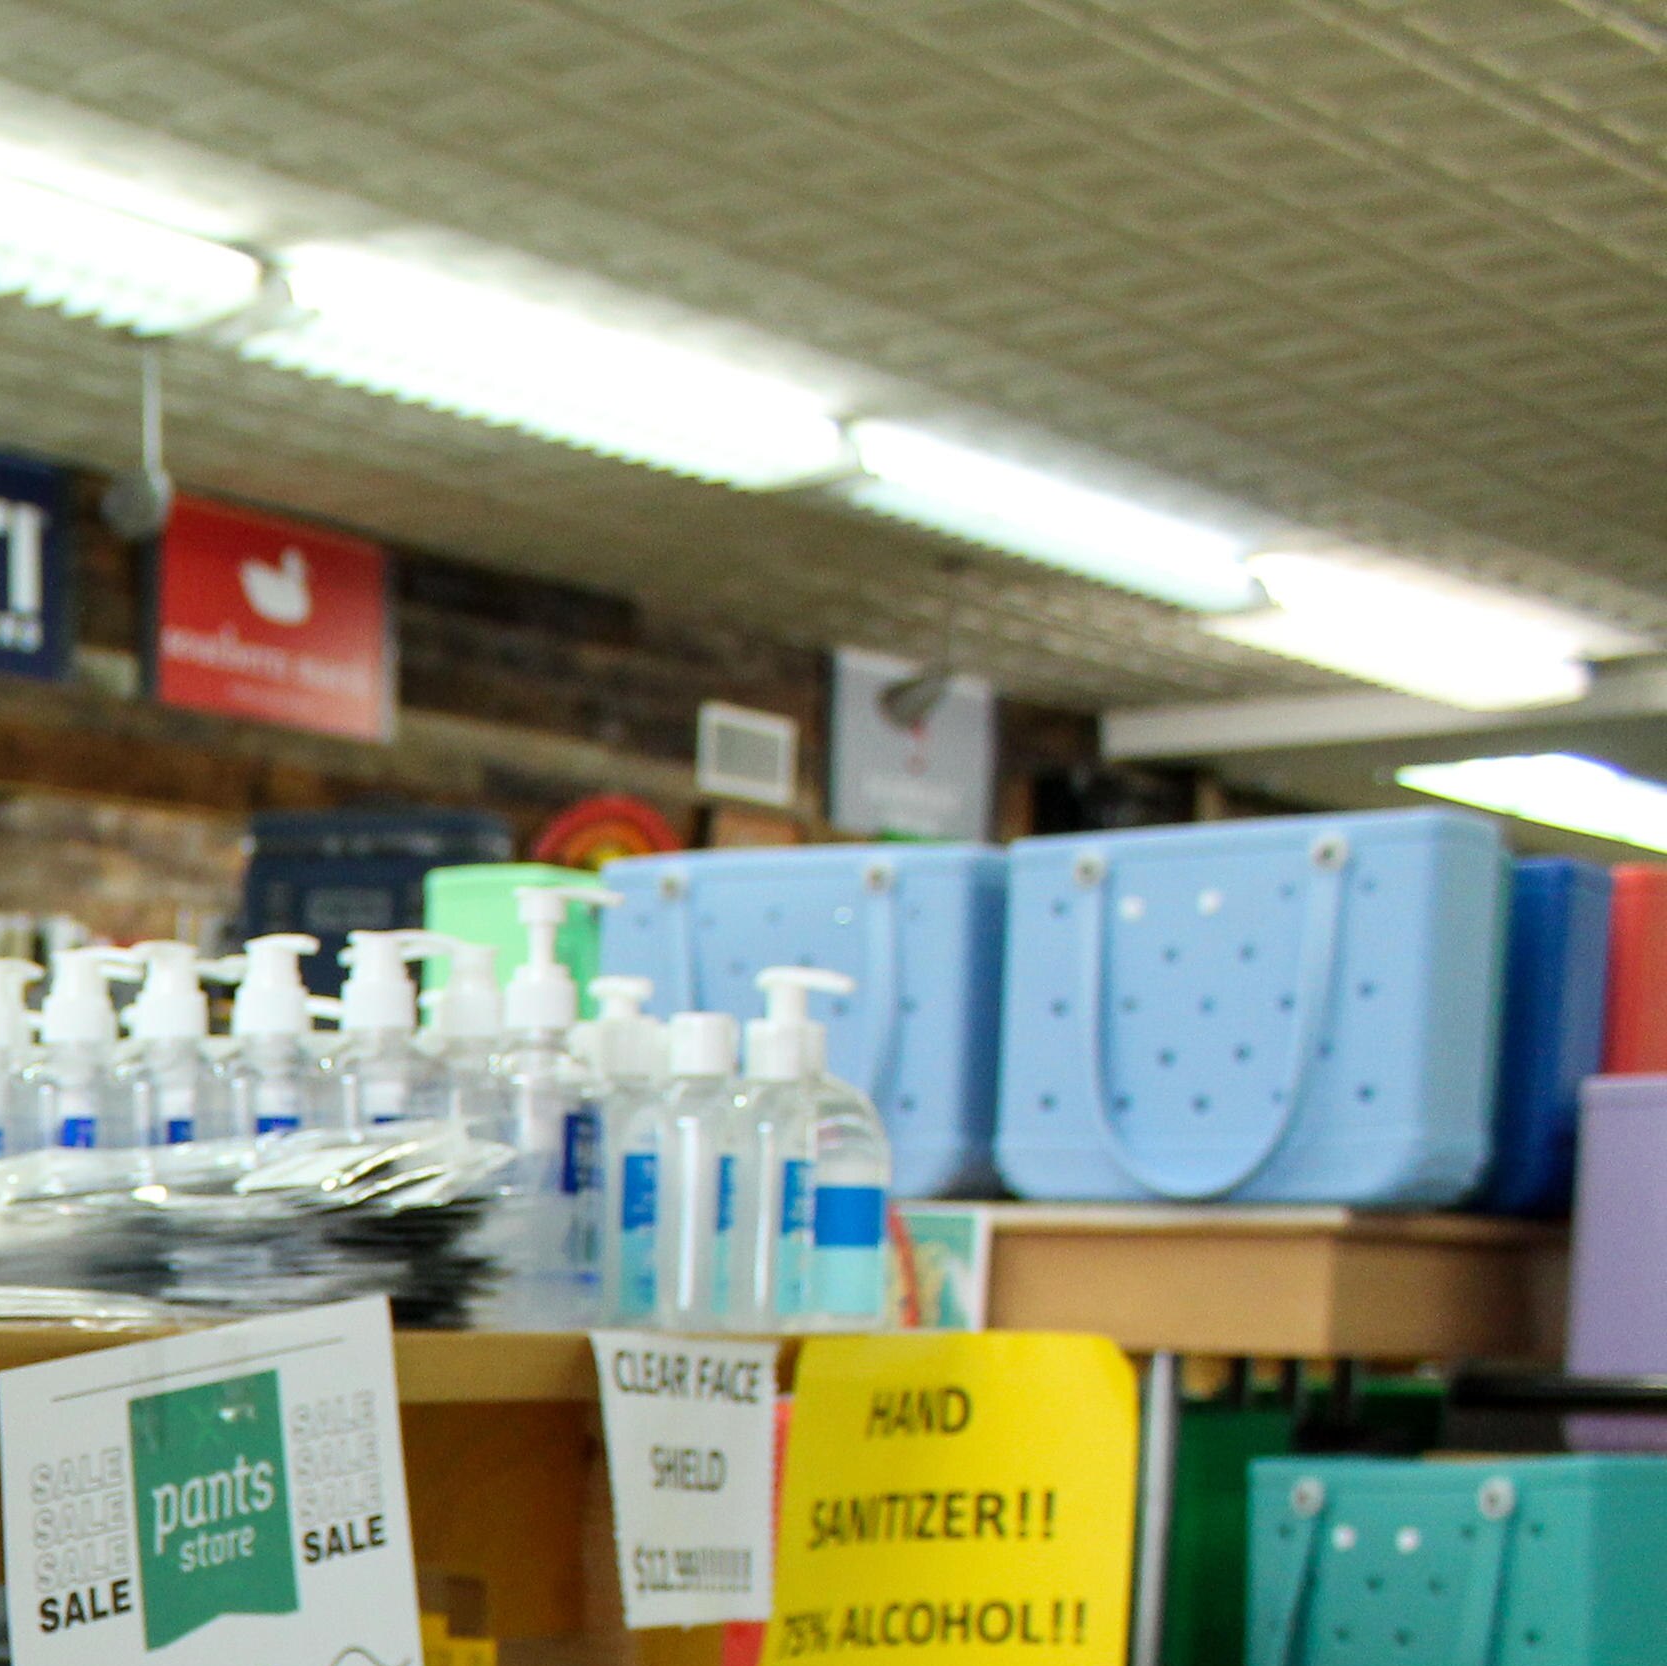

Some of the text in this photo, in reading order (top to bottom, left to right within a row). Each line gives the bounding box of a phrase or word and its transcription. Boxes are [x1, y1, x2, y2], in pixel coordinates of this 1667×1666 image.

[615, 1351, 761, 1403] CLEAR FACE
[866, 1385, 972, 1440] HAND
[30, 1446, 124, 1501] SALE
[651, 1447, 727, 1491] SHIELD
[32, 1489, 126, 1549] SALE
[152, 1454, 276, 1555] pants
[808, 1489, 1055, 1551] SANITIZER!!
[36, 1534, 128, 1592] SALE
[178, 1524, 257, 1573] store
[301, 1514, 388, 1565] SALE
[39, 1579, 132, 1634] SALE
[838, 1600, 1085, 1649] ALCOHOL!!
